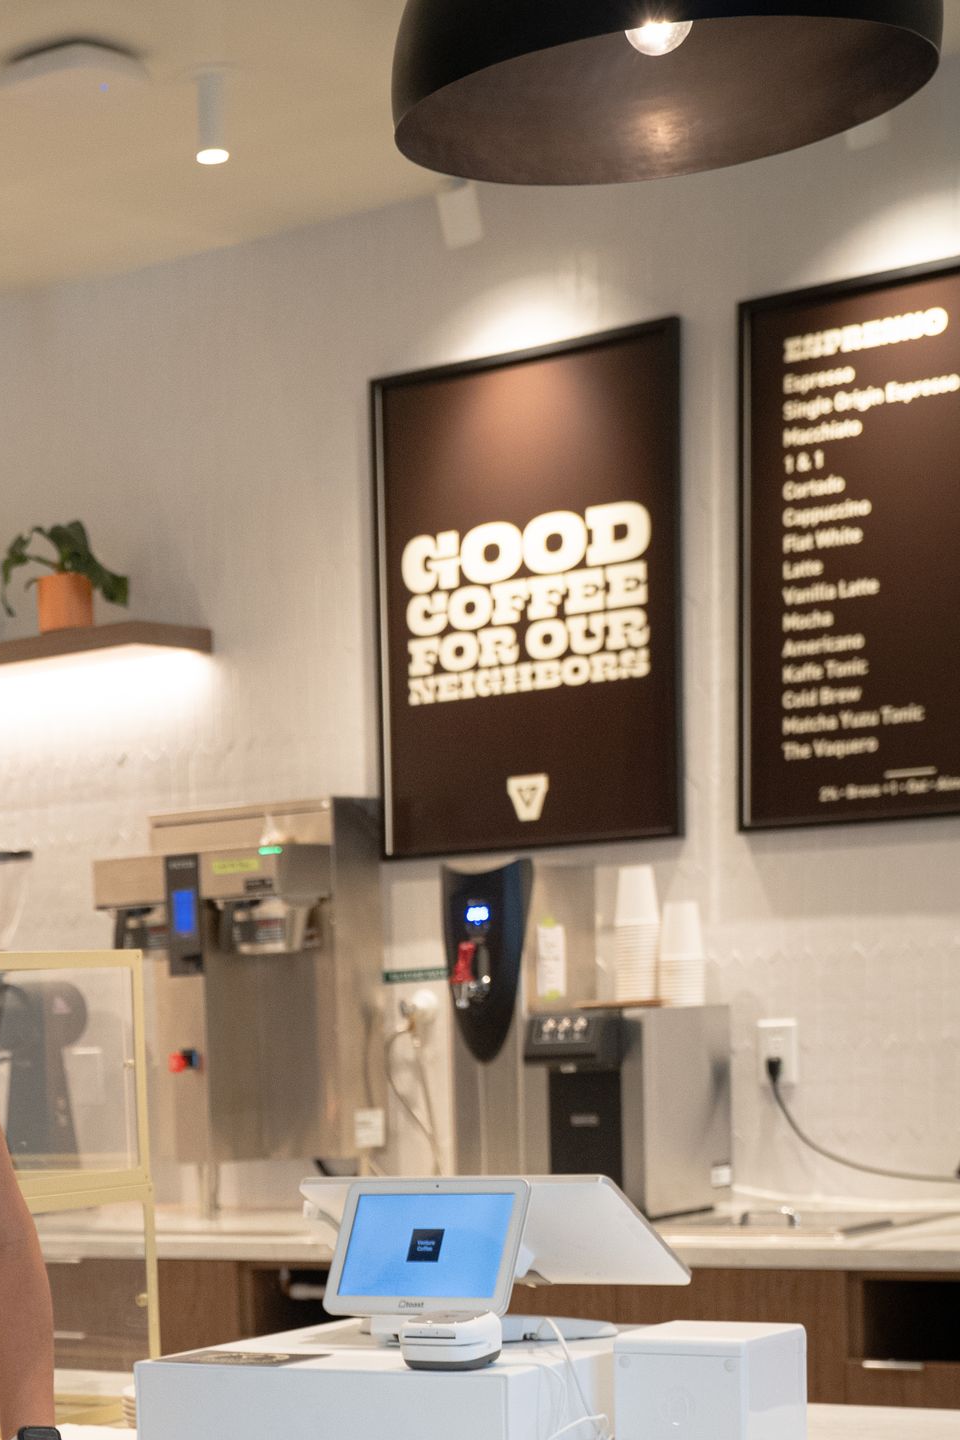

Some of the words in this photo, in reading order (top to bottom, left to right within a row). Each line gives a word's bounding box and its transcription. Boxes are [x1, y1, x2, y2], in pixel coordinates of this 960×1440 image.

[783, 306, 949, 364] ESPRESSO
[783, 366, 856, 395] Espresso
[783, 395, 834, 421] Single
[833, 385, 886, 412] Origin
[884, 373, 960, 404] Espresso
[783, 419, 863, 448] Macchiato
[796, 452, 813, 473] &
[782, 474, 846, 501] Cortado
[782, 498, 872, 528] Cappuccino
[401, 500, 652, 594] GOOD
[782, 532, 815, 554] Flat
[814, 525, 864, 549] White
[782, 559, 825, 580] Latte
[406, 559, 649, 637] COFFEE
[781, 581, 838, 606] Vanilla
[837, 576, 881, 600] Latte
[782, 608, 835, 632] Mocha
[407, 625, 520, 678] FOR
[525, 606, 651, 661] OUR
[781, 632, 866, 659] Americano
[408, 647, 651, 707] NEIGHBORS
[824, 655, 869, 679] Tonic
[782, 686, 819, 710] Cold
[819, 685, 863, 706] Brew
[782, 712, 839, 736] Matcha
[839, 708, 880, 730] Yuzu
[880, 702, 926, 725] Tonic
[781, 741, 813, 761] The
[812, 736, 879, 760] Vaquero
